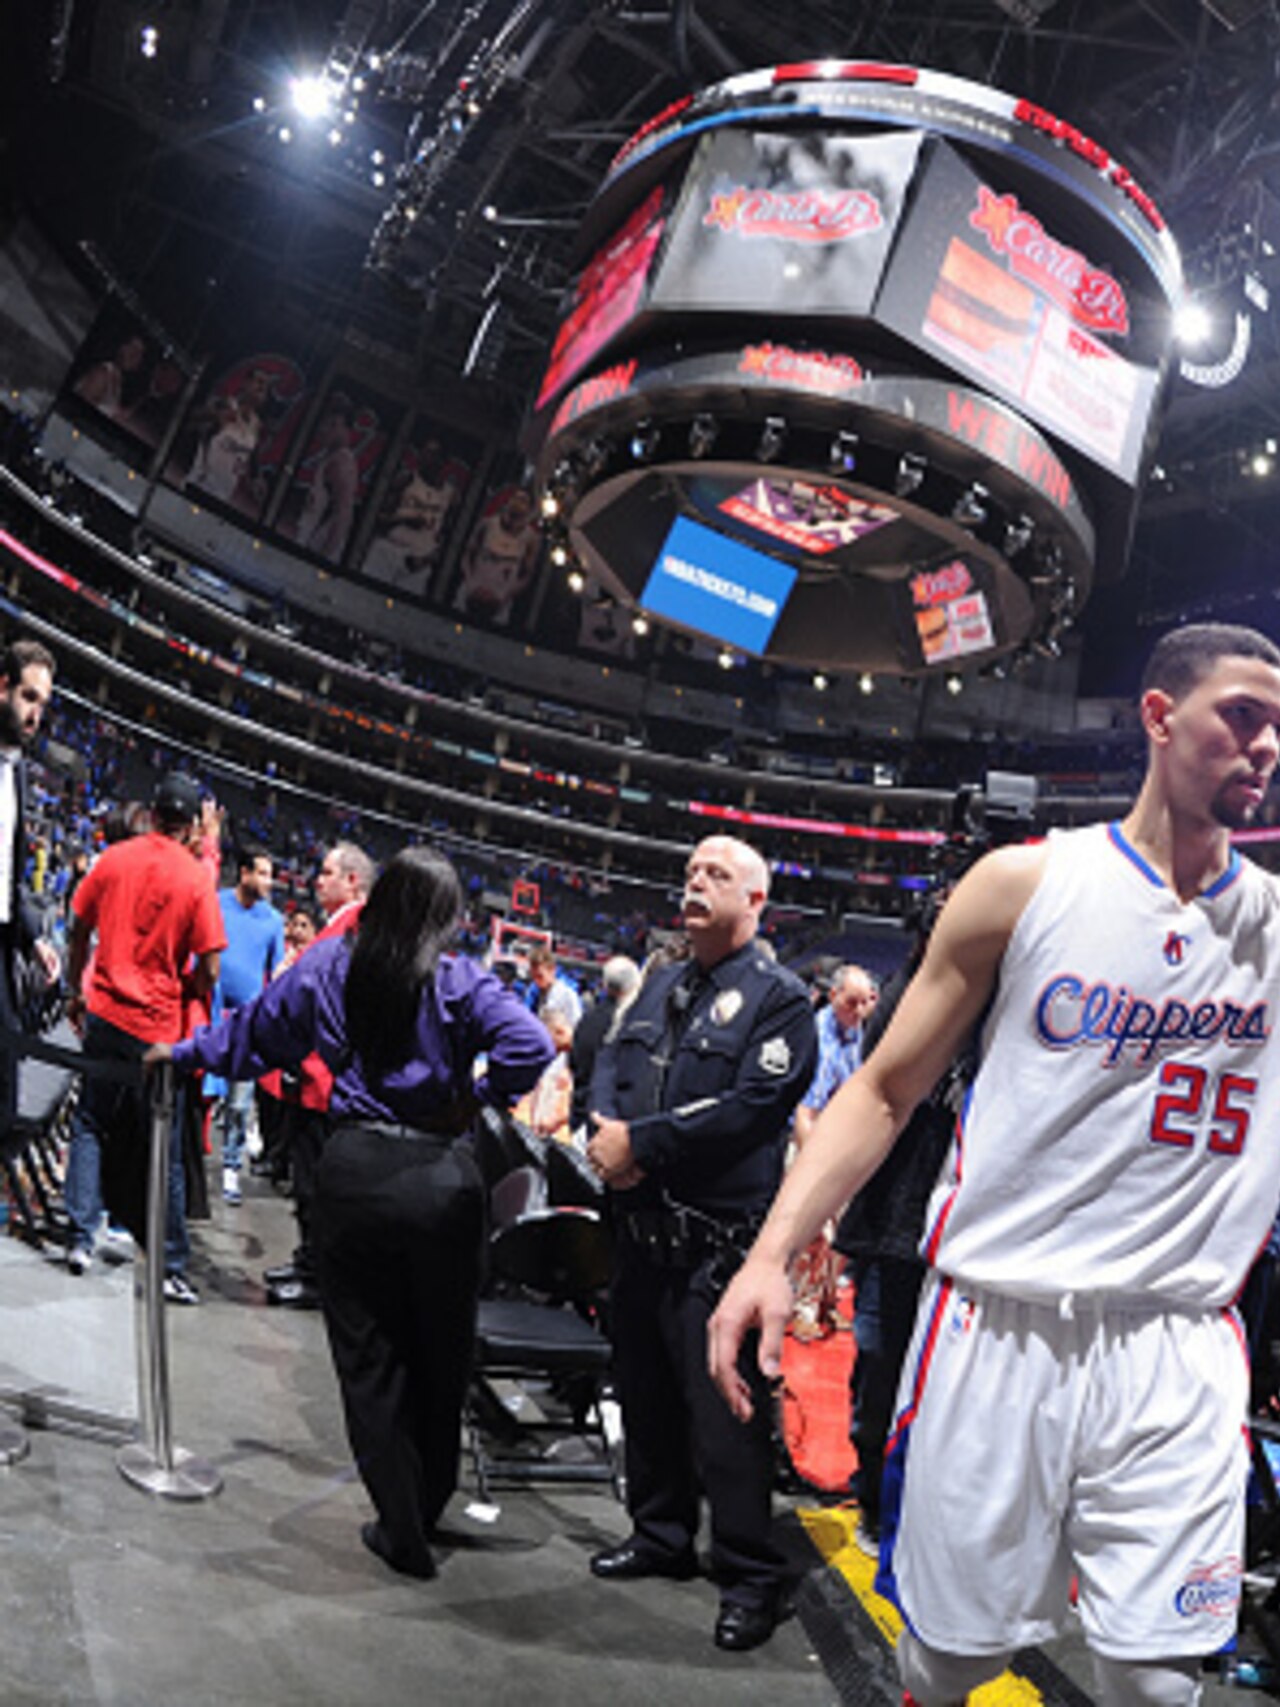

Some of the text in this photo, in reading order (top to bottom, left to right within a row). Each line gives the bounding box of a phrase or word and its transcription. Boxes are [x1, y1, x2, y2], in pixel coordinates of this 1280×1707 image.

[947, 390, 1071, 509] WE WIN
[1033, 972, 1271, 1070] Clippers
[1150, 1060, 1259, 1156] 25
